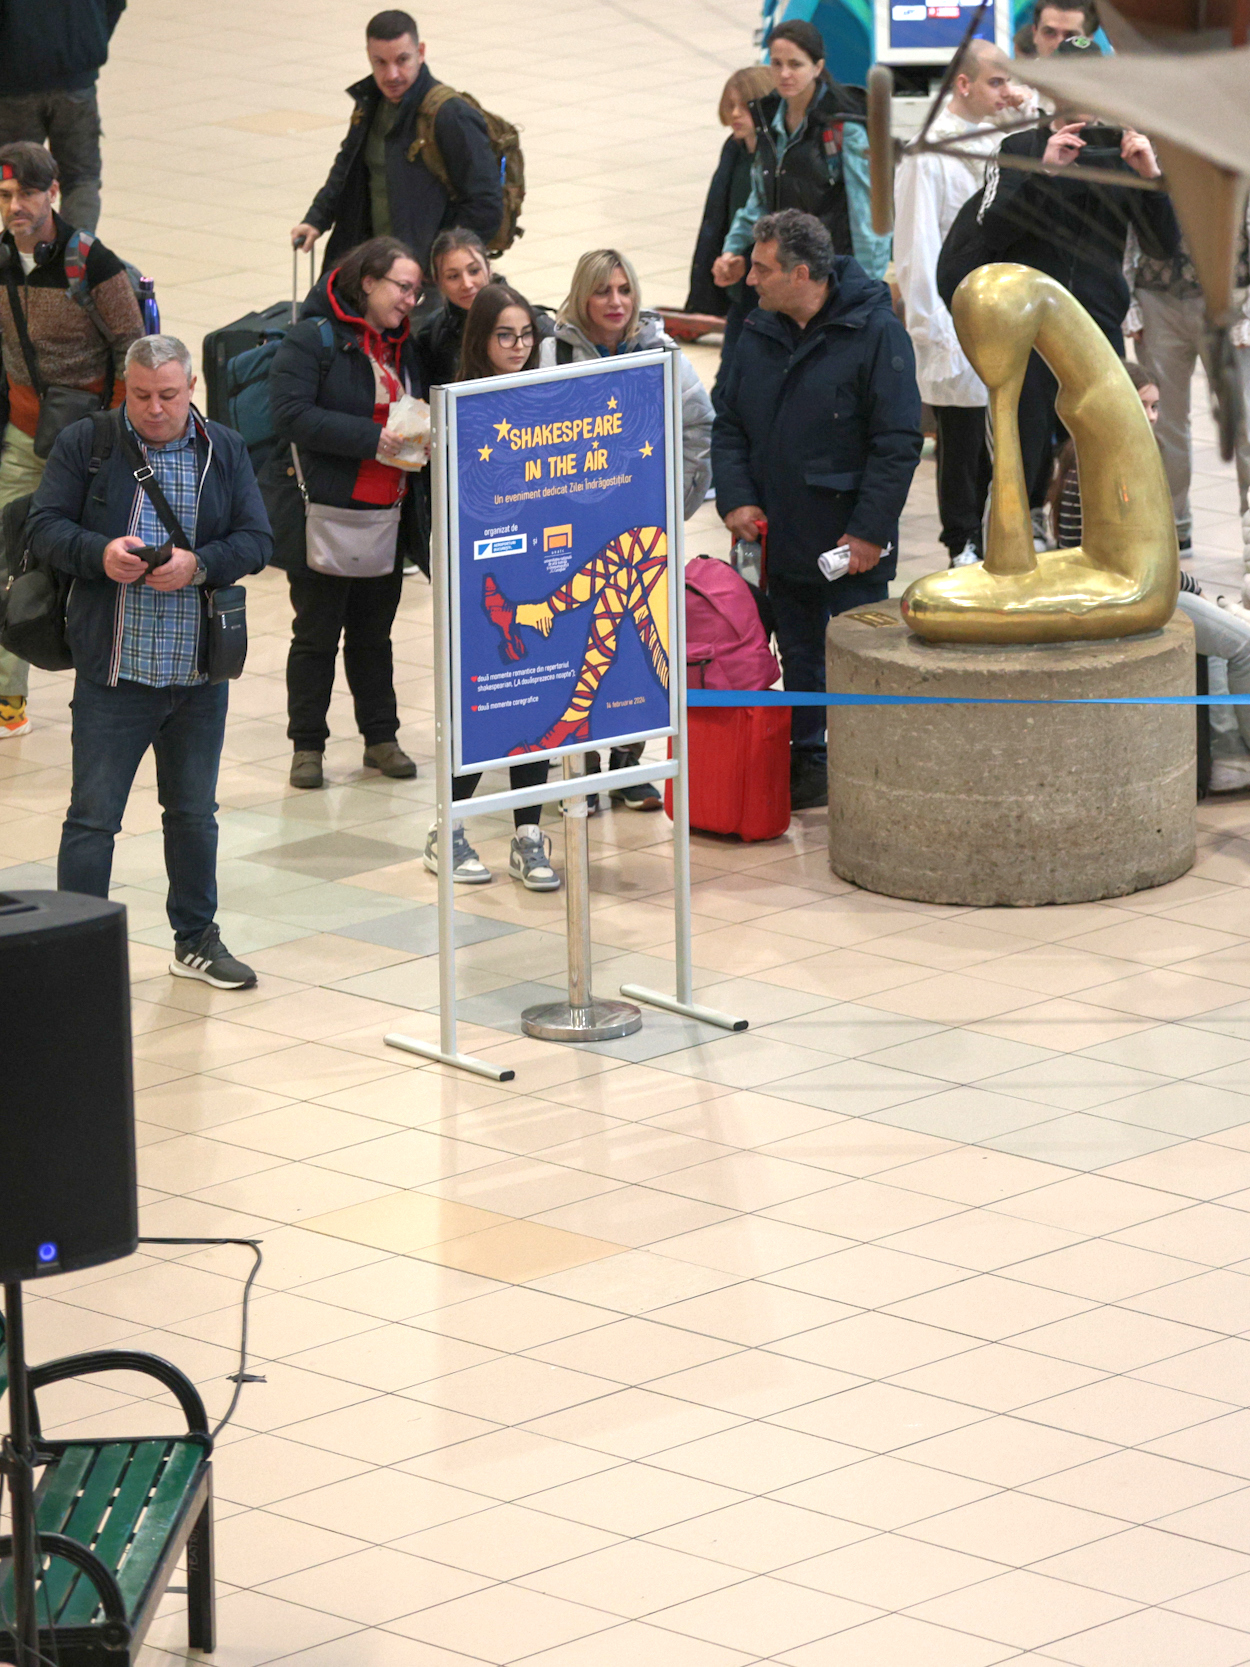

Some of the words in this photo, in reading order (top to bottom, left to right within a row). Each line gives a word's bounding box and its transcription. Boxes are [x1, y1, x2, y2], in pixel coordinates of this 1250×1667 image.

[509, 413, 623, 451] SHAKESPEARE
[525, 458, 542, 482] IN
[547, 453, 577, 478] THE
[583, 449, 608, 472] AIR
[494, 494, 504, 505] Un
[505, 489, 541, 503] eveniment
[542, 485, 568, 497] dedicat
[569, 481, 584, 493] Zilei
[484, 525, 511, 537] organizat
[511, 523, 519, 532] de
[490, 671, 512, 680] momente
[512, 667, 536, 677] romantice
[490, 700, 512, 709] momente
